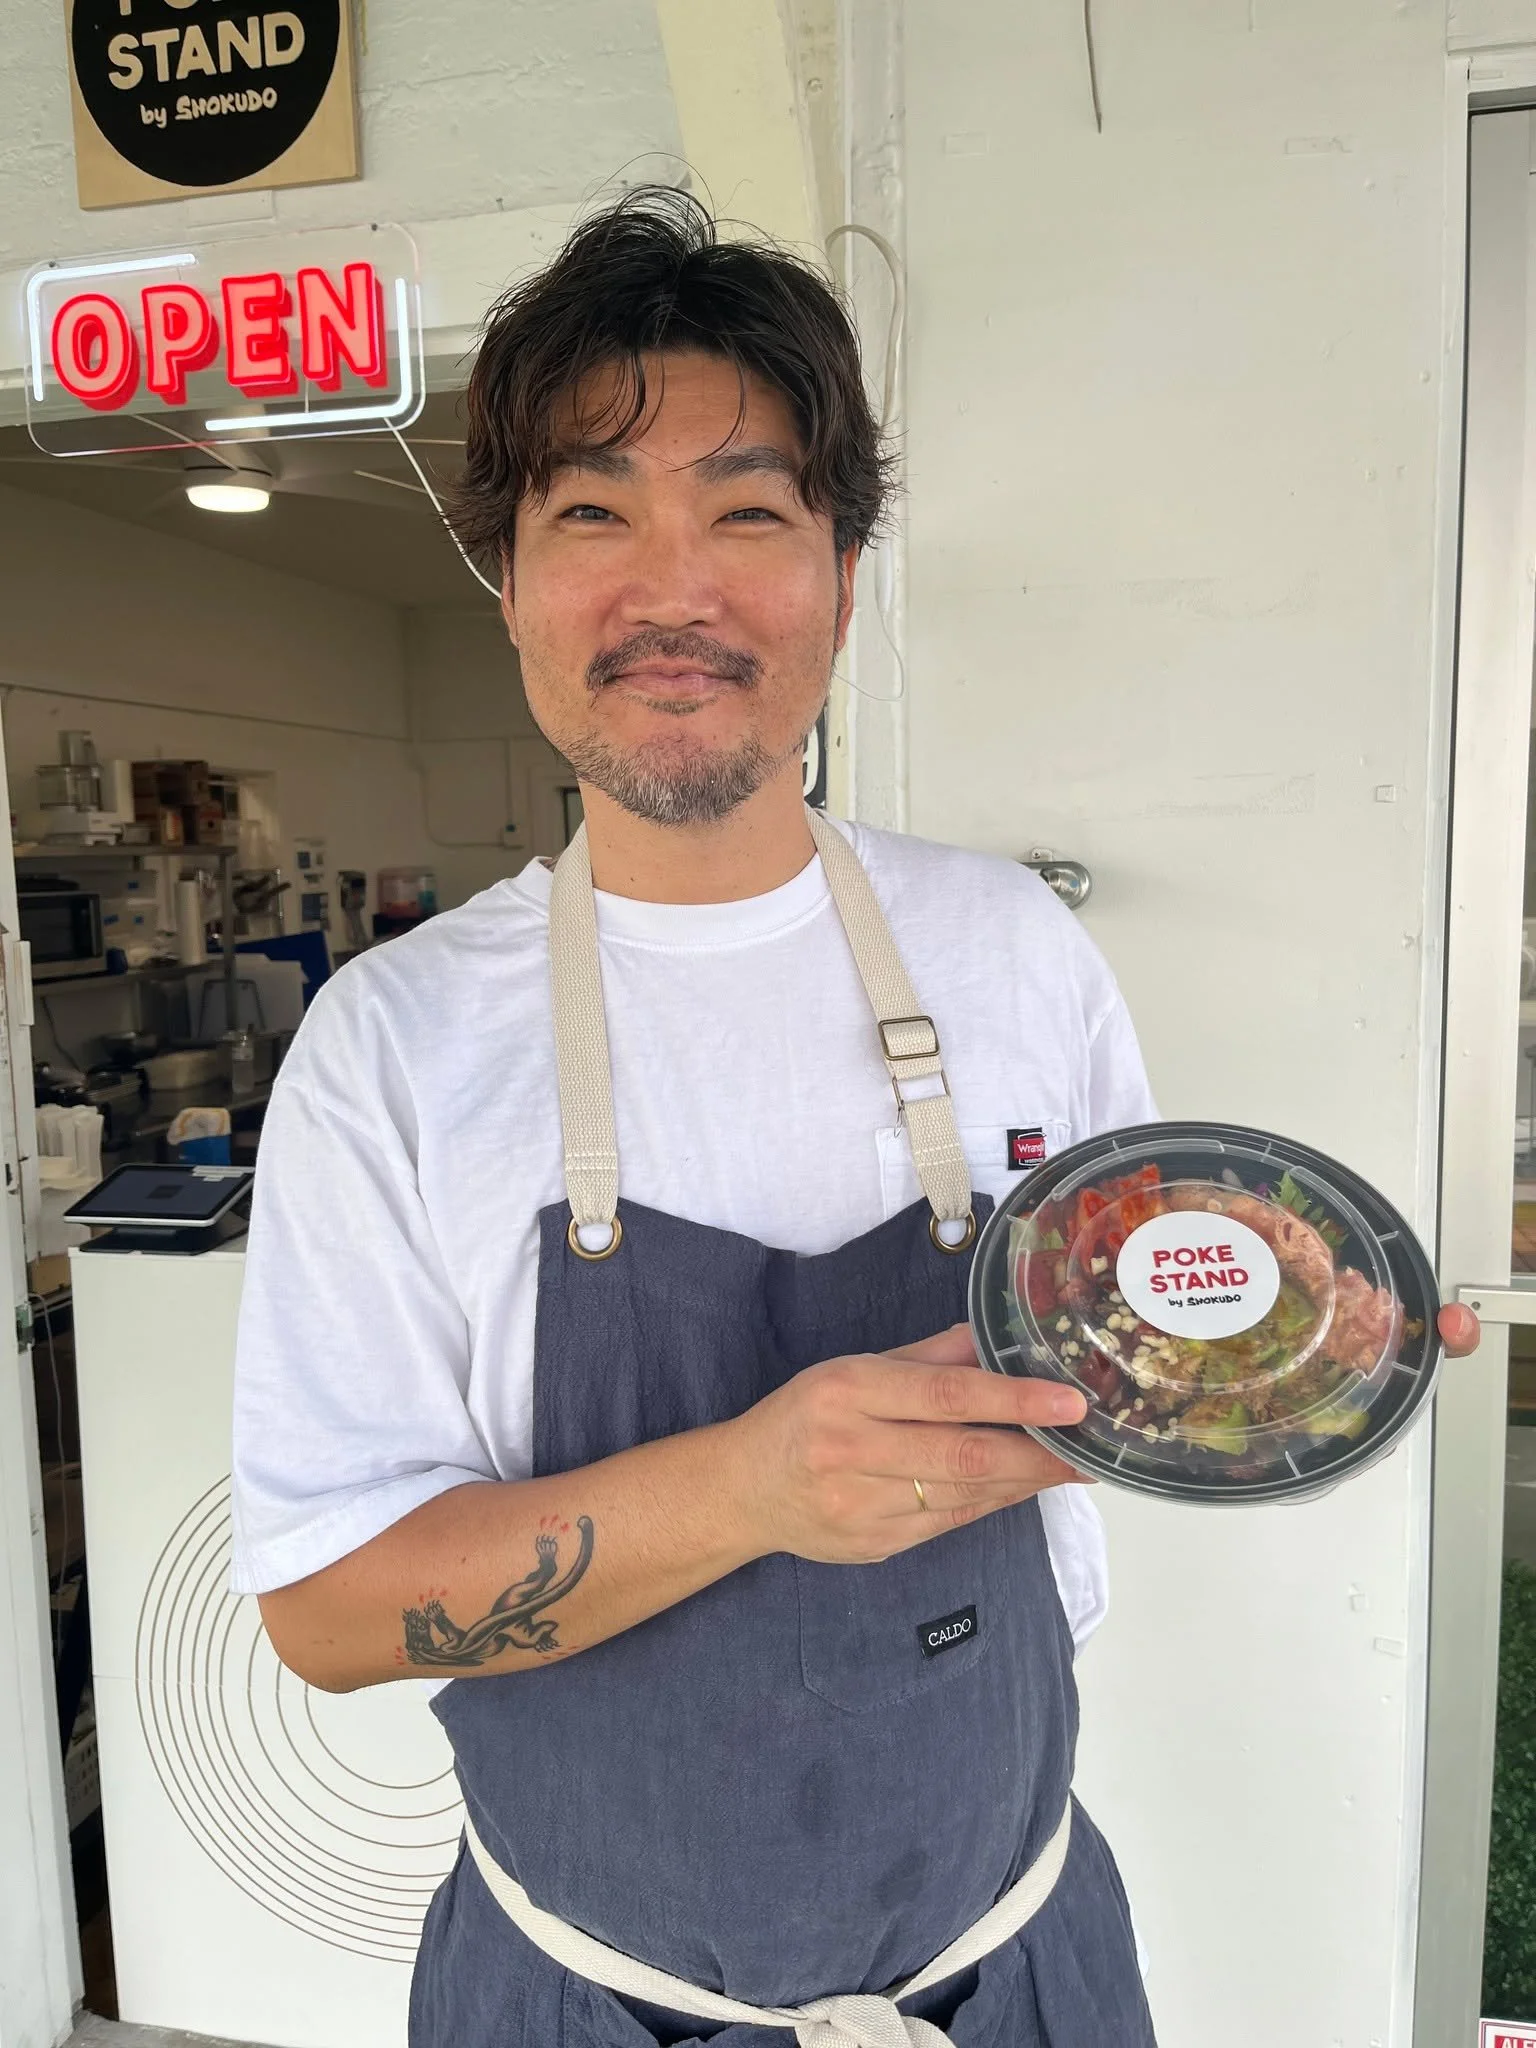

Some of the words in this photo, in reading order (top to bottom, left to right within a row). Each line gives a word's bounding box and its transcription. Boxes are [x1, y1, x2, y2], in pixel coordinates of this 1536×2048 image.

[107, 11, 306, 91] STAND
[140, 104, 167, 129] by
[175, 87, 278, 120] SHOKUDO
[51, 262, 389, 412] OPEN
[1152, 1244, 1235, 1268] POKE
[1149, 1268, 1249, 1294] STAND
[1168, 1298, 1183, 1308] by
[1187, 1294, 1242, 1307] SHOKUDO
[928, 1618, 972, 1647] CALDO
